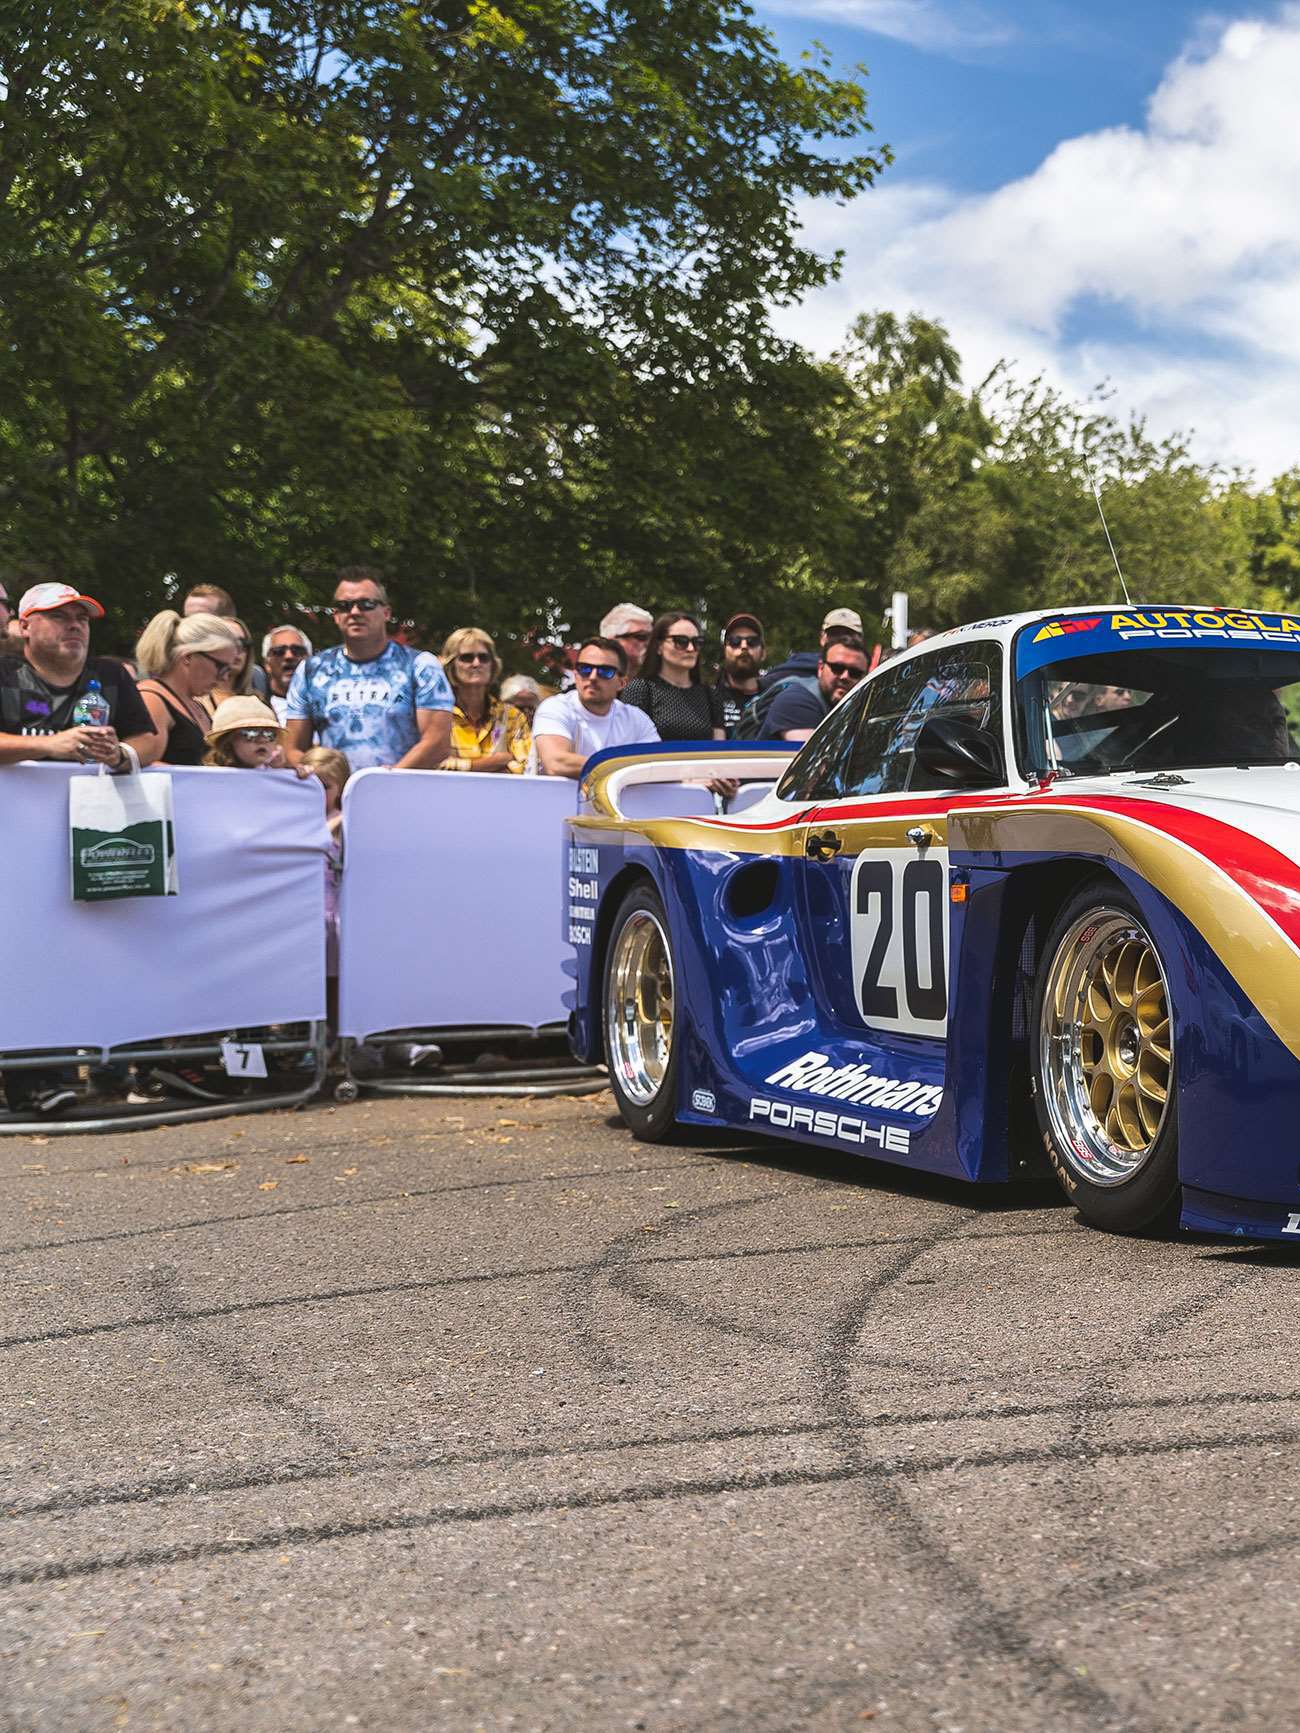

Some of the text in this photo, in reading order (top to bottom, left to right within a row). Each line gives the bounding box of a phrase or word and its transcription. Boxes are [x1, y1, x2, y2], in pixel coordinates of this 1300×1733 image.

[568, 877, 598, 900] Shell
[569, 925, 592, 945] BOSCH
[857, 860, 947, 1021] 20
[235, 1050, 249, 1069] 7
[764, 1051, 944, 1117] Rothmans
[749, 1098, 910, 1154] PORSCHE
